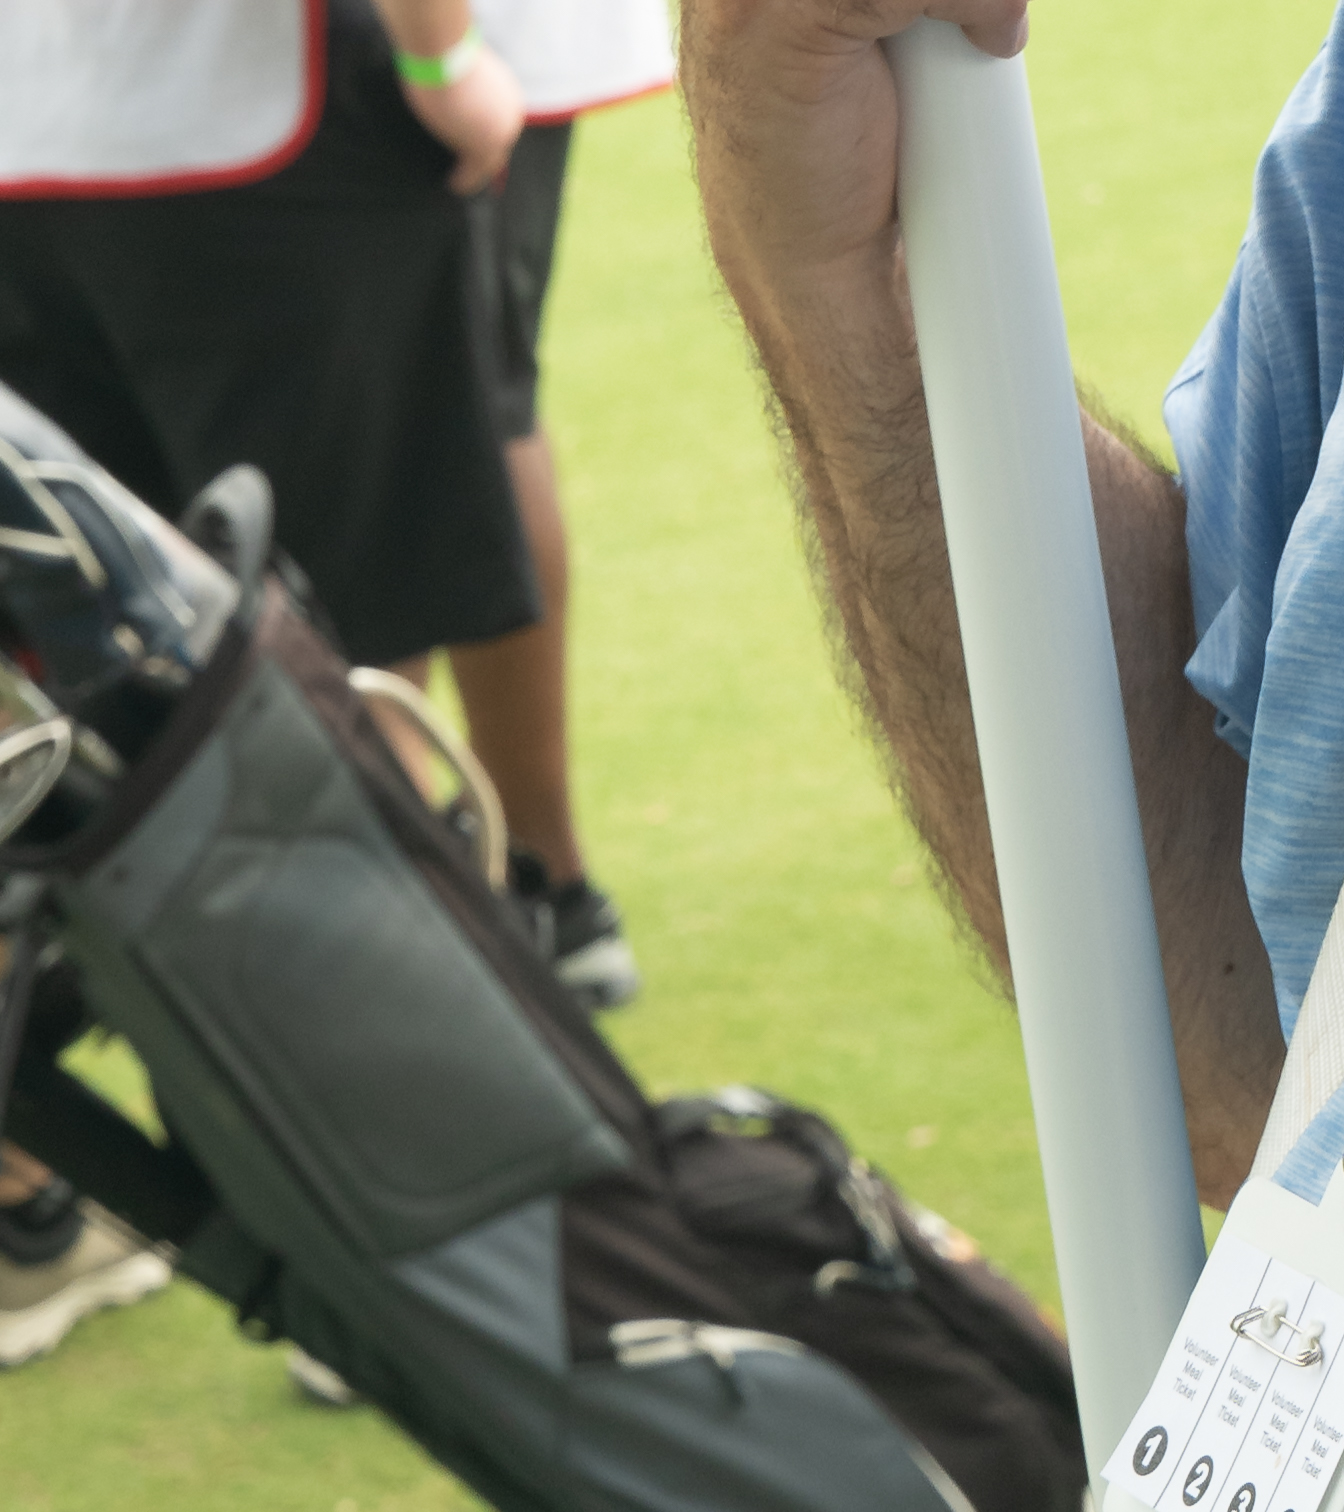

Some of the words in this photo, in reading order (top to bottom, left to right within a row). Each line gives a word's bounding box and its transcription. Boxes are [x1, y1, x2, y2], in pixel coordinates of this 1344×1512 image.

[1184, 1336, 1219, 1366] Volunteer
[1182, 1360, 1204, 1381] Meal
[1229, 1364, 1261, 1392] Volunteer
[1173, 1377, 1197, 1402] Ticket
[1227, 1387, 1247, 1407] Meal
[1271, 1389, 1304, 1418] Volunteer
[1218, 1405, 1240, 1427] Ticket
[1269, 1413, 1289, 1433] Meal
[1313, 1415, 1344, 1443] Volunteer
[1141, 1433, 1163, 1468] 1
[1260, 1430, 1282, 1454] Ticket
[1311, 1439, 1330, 1459] Meal
[1301, 1456, 1322, 1480] Ticket
[1185, 1462, 1210, 1499] 2
